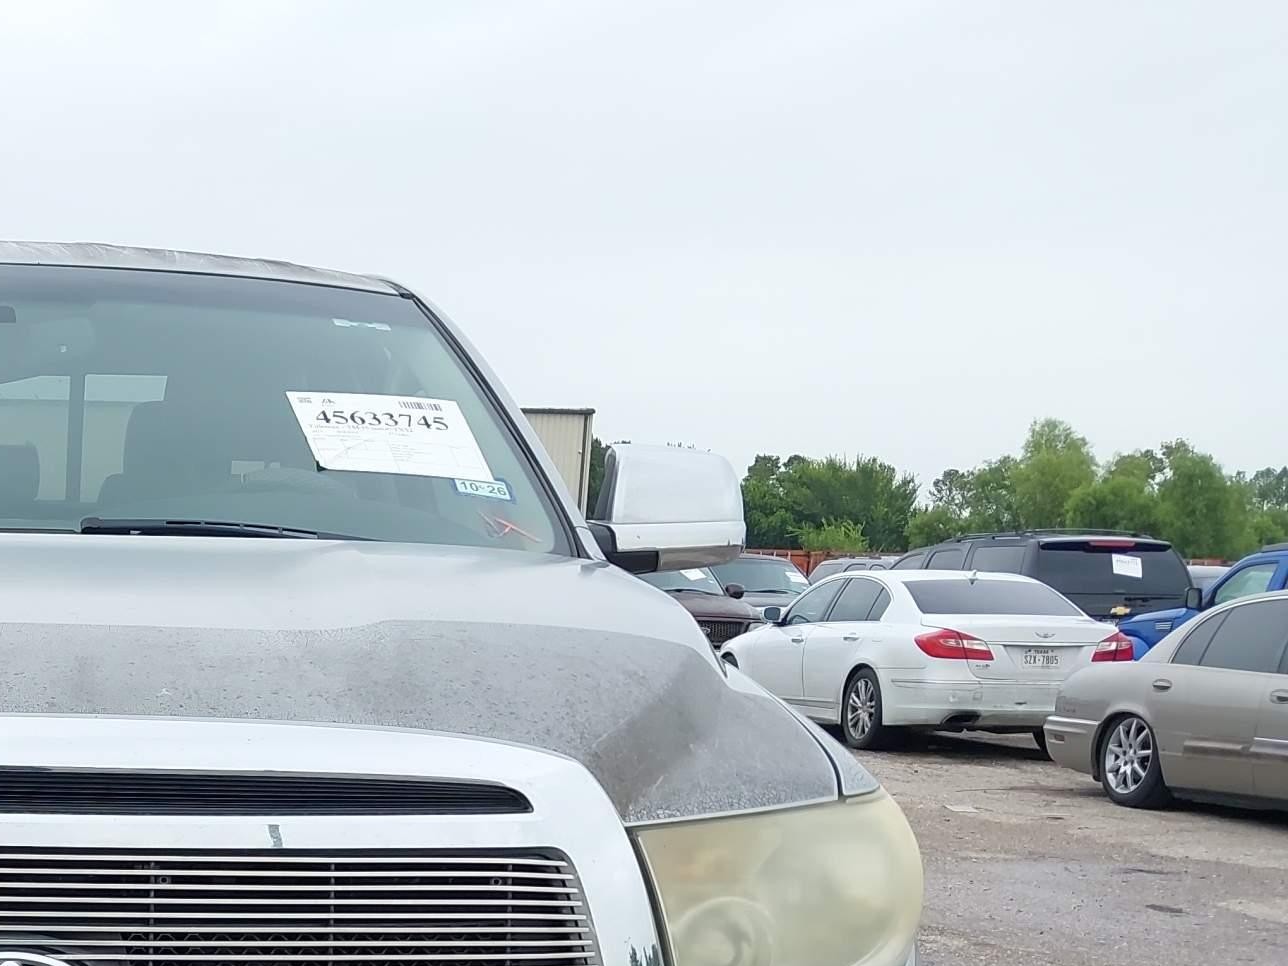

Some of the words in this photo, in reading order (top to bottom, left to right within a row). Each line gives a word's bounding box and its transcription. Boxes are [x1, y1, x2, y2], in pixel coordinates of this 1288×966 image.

[316, 409, 449, 431] 45633745
[460, 481, 479, 492] 10
[487, 485, 507, 496] 26
